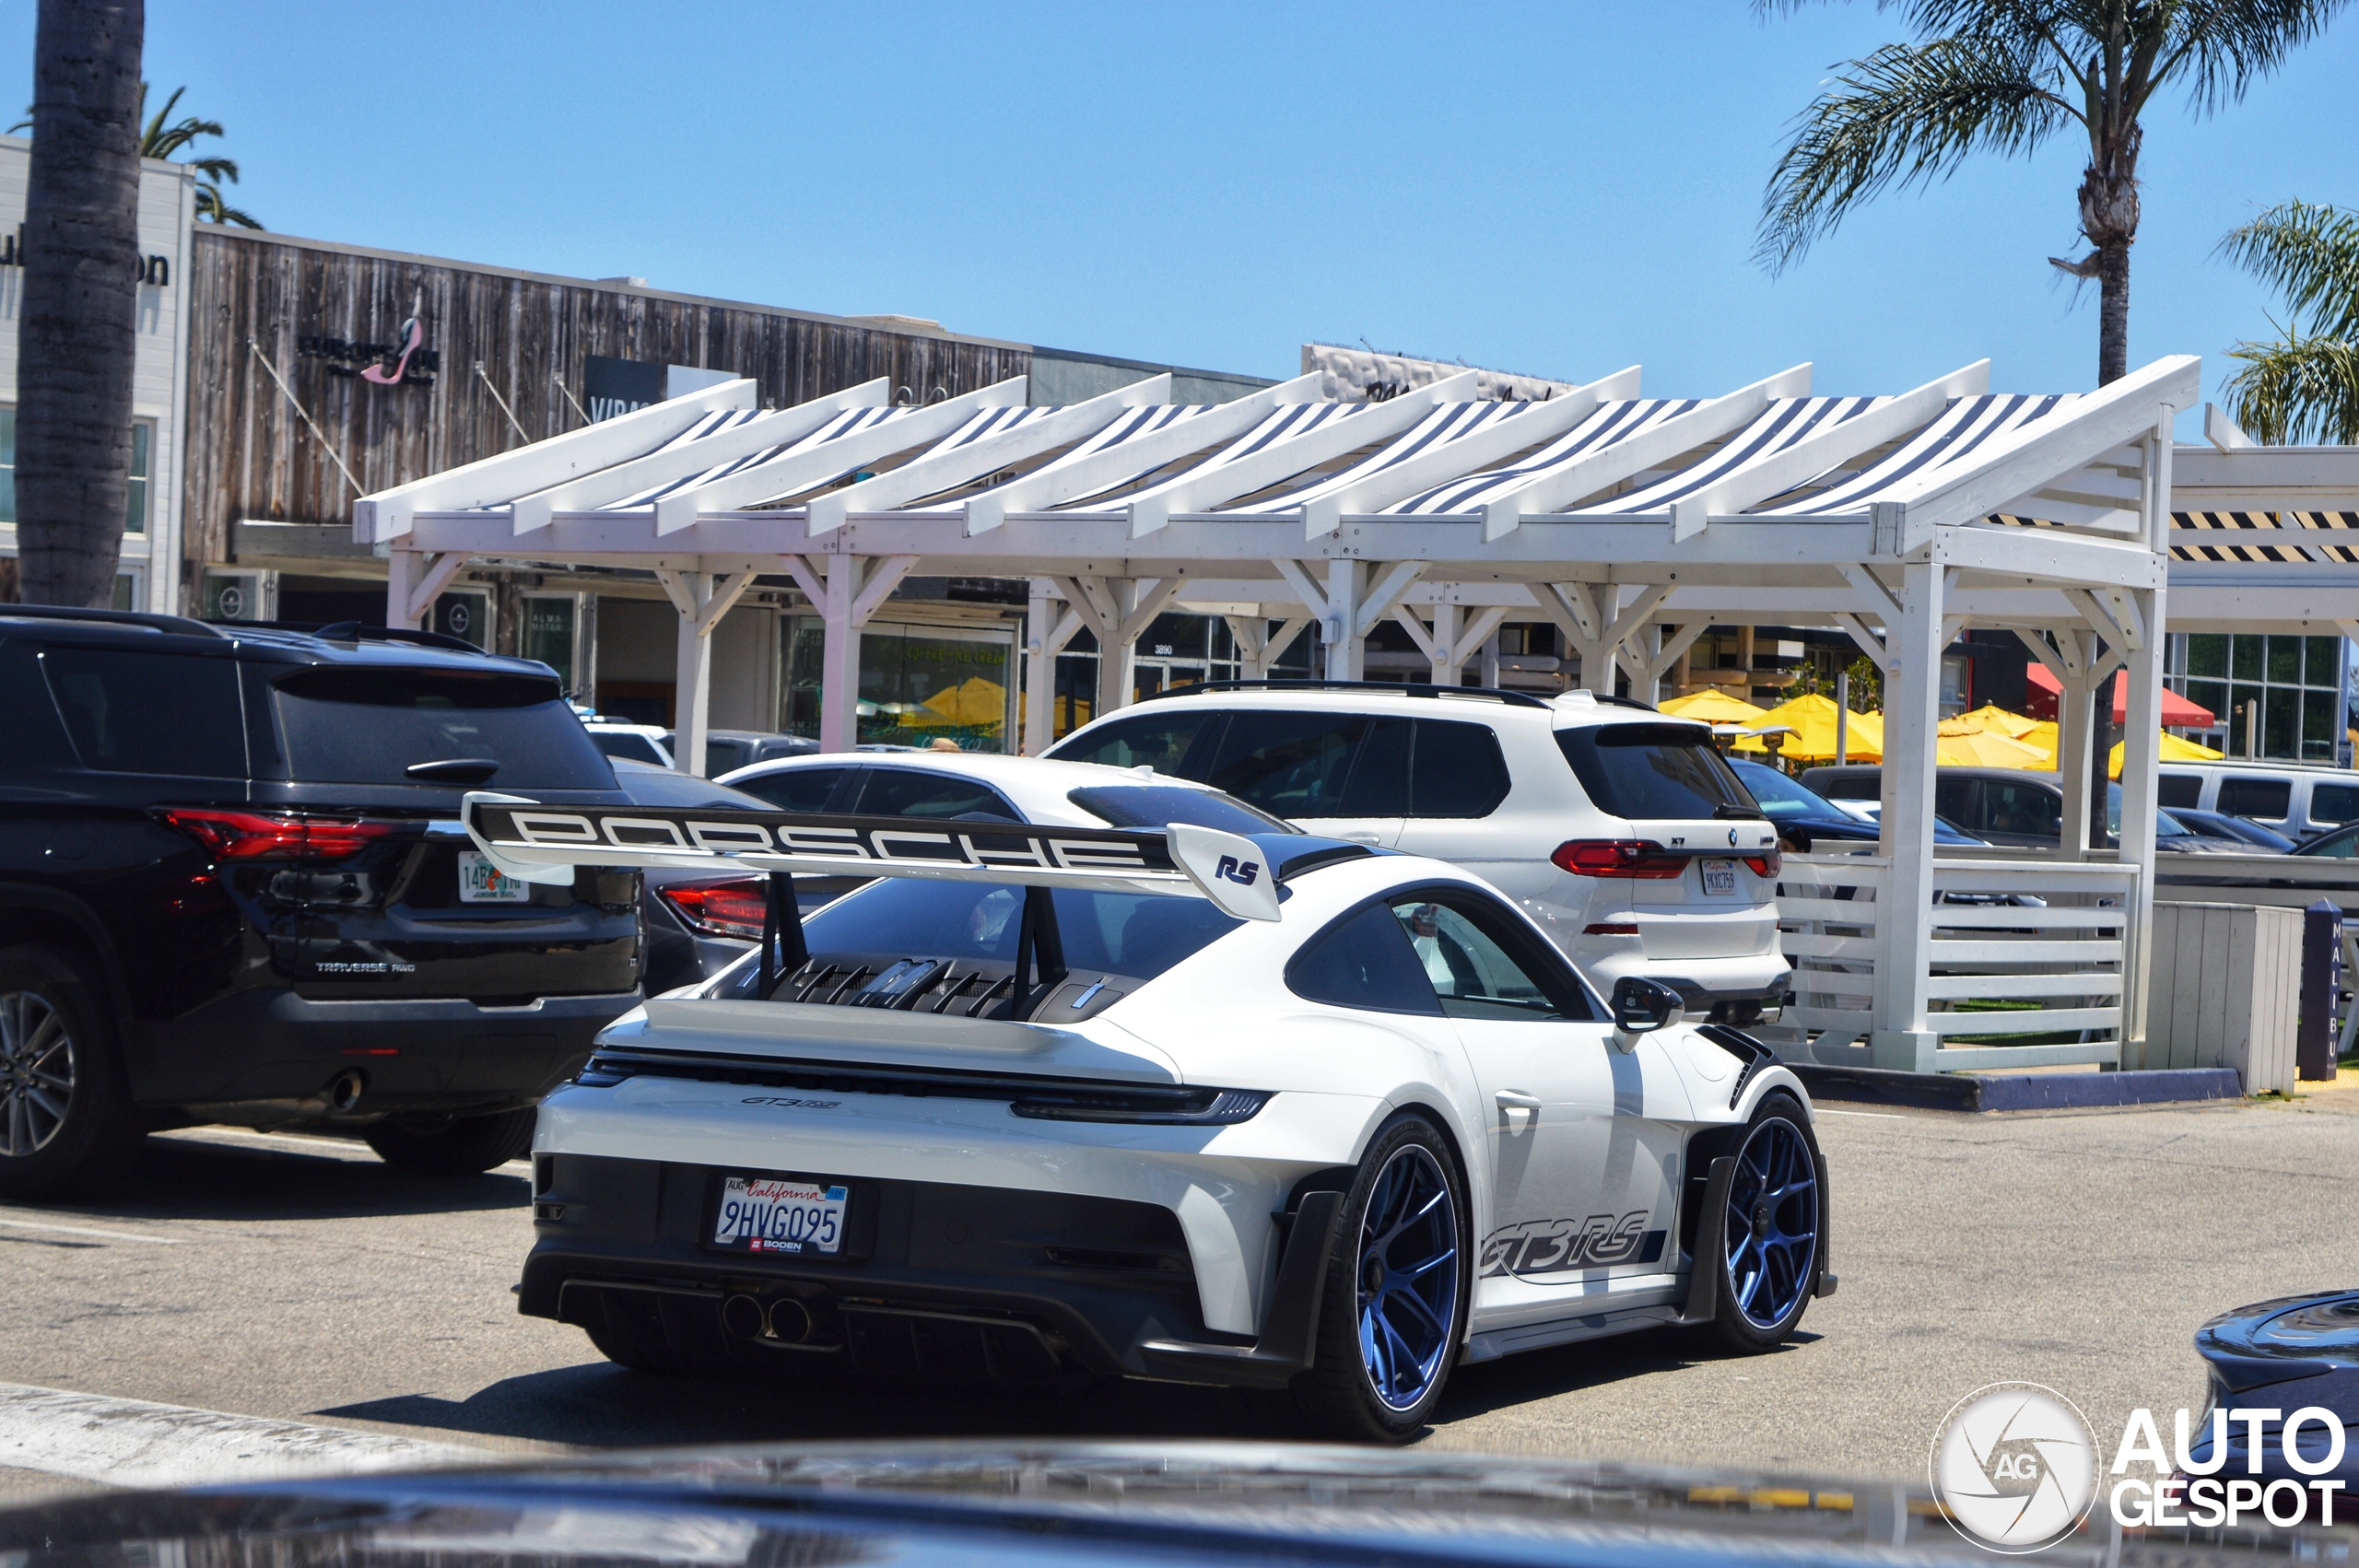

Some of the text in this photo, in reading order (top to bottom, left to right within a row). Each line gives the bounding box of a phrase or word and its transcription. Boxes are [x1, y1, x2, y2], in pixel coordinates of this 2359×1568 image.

[533, 614, 561, 623] ALMA
[531, 623, 563, 632] MATER
[906, 646, 945, 662] COFFEE
[1155, 644, 1172, 655] 3890
[510, 812, 1144, 869] PORSCHE
[1215, 854, 1260, 887] RS
[1706, 872, 1734, 890] 9KXC759
[315, 962, 417, 973] TRAVERSE AWD
[2329, 922, 2341, 1058] MALIBU
[727, 1180, 745, 1190] AUG
[746, 1179, 827, 1204] California
[721, 1200, 838, 1244] 9HVG095
[763, 1239, 802, 1250] BODEN
